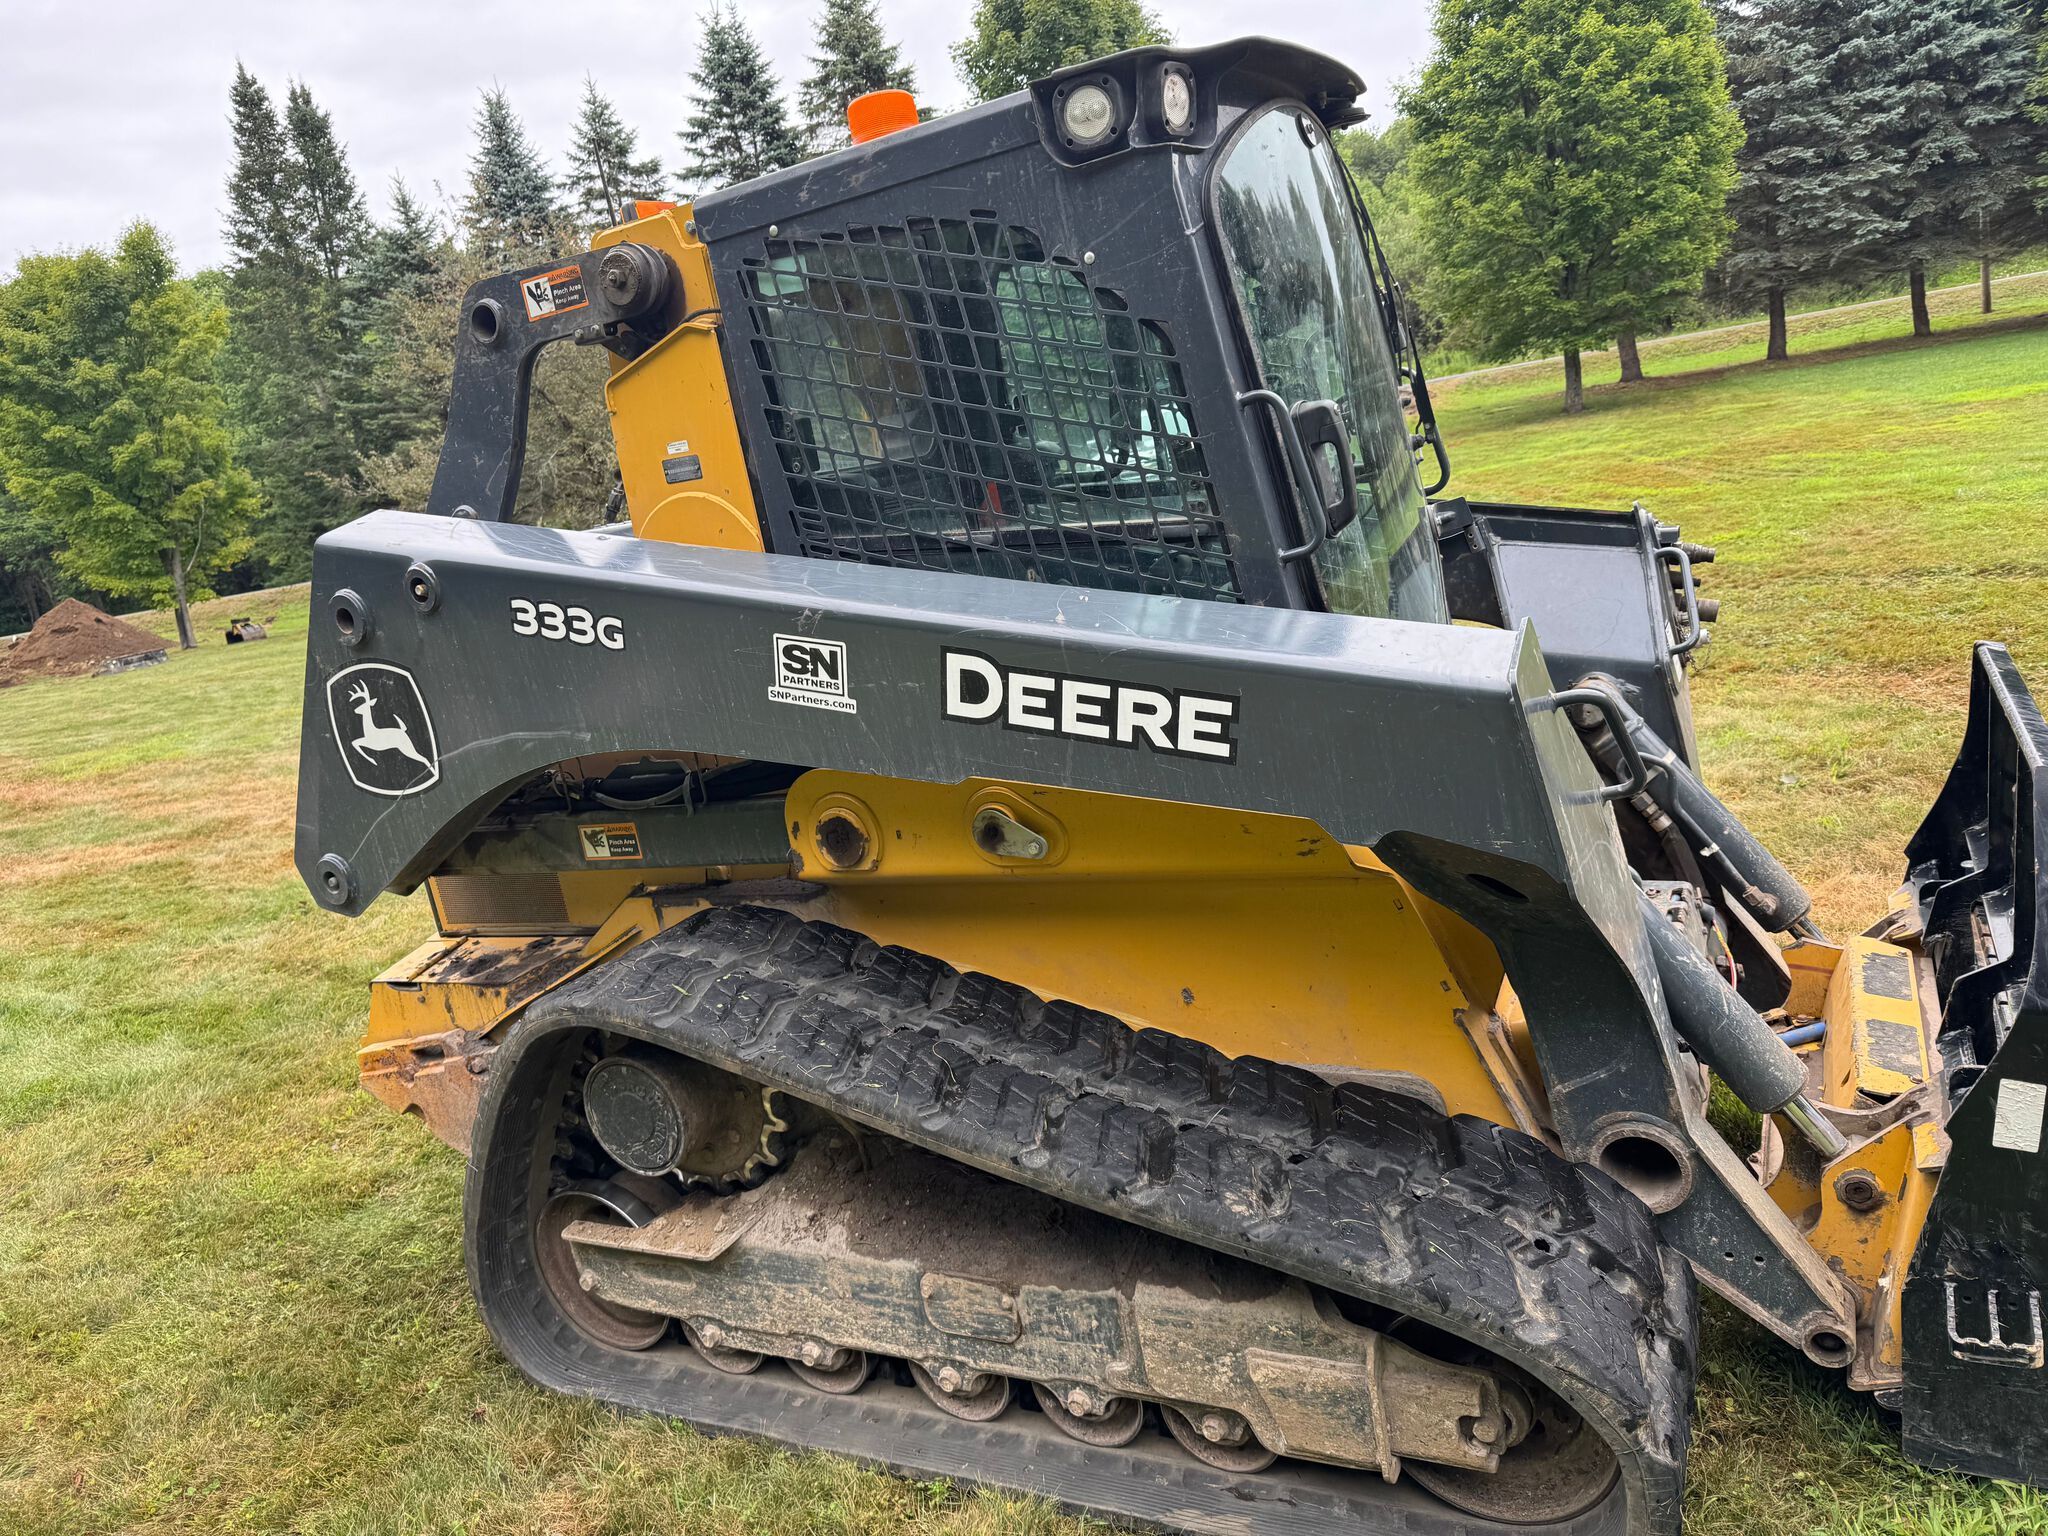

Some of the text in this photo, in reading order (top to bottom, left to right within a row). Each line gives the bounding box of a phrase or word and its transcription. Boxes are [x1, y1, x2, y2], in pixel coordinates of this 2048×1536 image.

[553, 284, 582, 296] Pinch Area
[510, 598, 625, 650] 333G
[783, 675, 841, 691] PARTNERS
[769, 689, 856, 711] SNPartners.com
[945, 651, 1234, 758] DEERE
